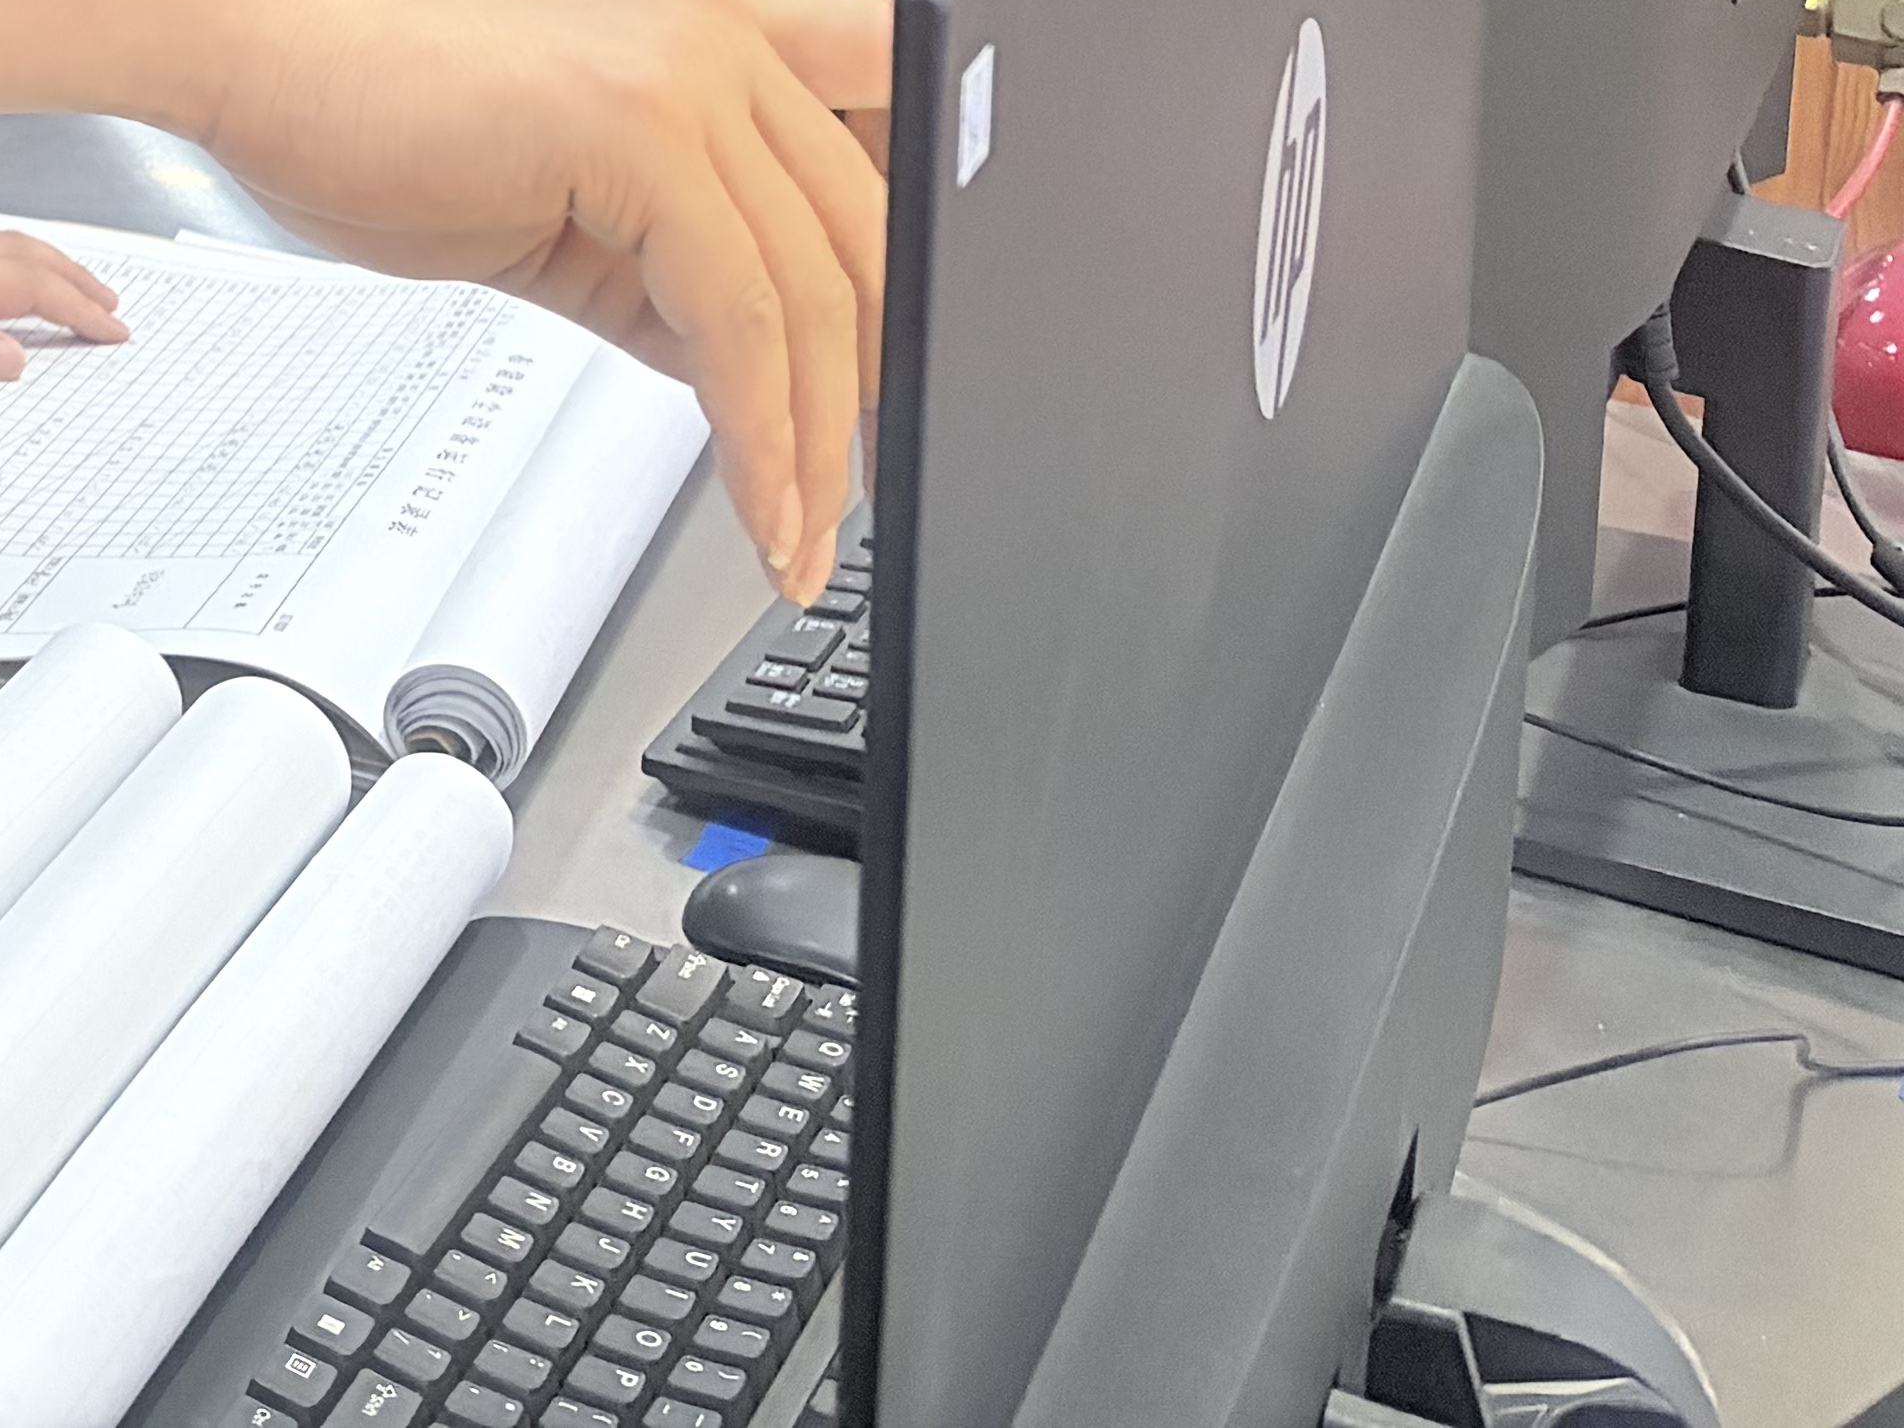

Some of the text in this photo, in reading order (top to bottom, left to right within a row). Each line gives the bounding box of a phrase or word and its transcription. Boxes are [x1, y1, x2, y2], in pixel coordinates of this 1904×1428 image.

[646, 1023, 670, 1040] Z
[734, 1030, 758, 1045] A
[624, 1056, 649, 1074] X
[715, 1063, 739, 1078] S
[798, 1074, 825, 1093] W
[601, 1090, 625, 1106] C
[693, 1095, 718, 1111] D
[778, 1106, 804, 1122] E
[579, 1126, 603, 1142] V
[673, 1130, 695, 1147] F
[756, 1141, 782, 1158] R
[552, 1156, 577, 1173] B
[645, 1166, 670, 1182] G
[734, 1180, 759, 1194] T
[525, 1191, 552, 1212] N
[621, 1201, 648, 1220] H
[711, 1217, 737, 1231] Y
[497, 1228, 526, 1250] M
[598, 1237, 621, 1254] J
[685, 1251, 712, 1268] U
[570, 1275, 598, 1294] K
[545, 1314, 572, 1327] L
[615, 1369, 639, 1387] P
